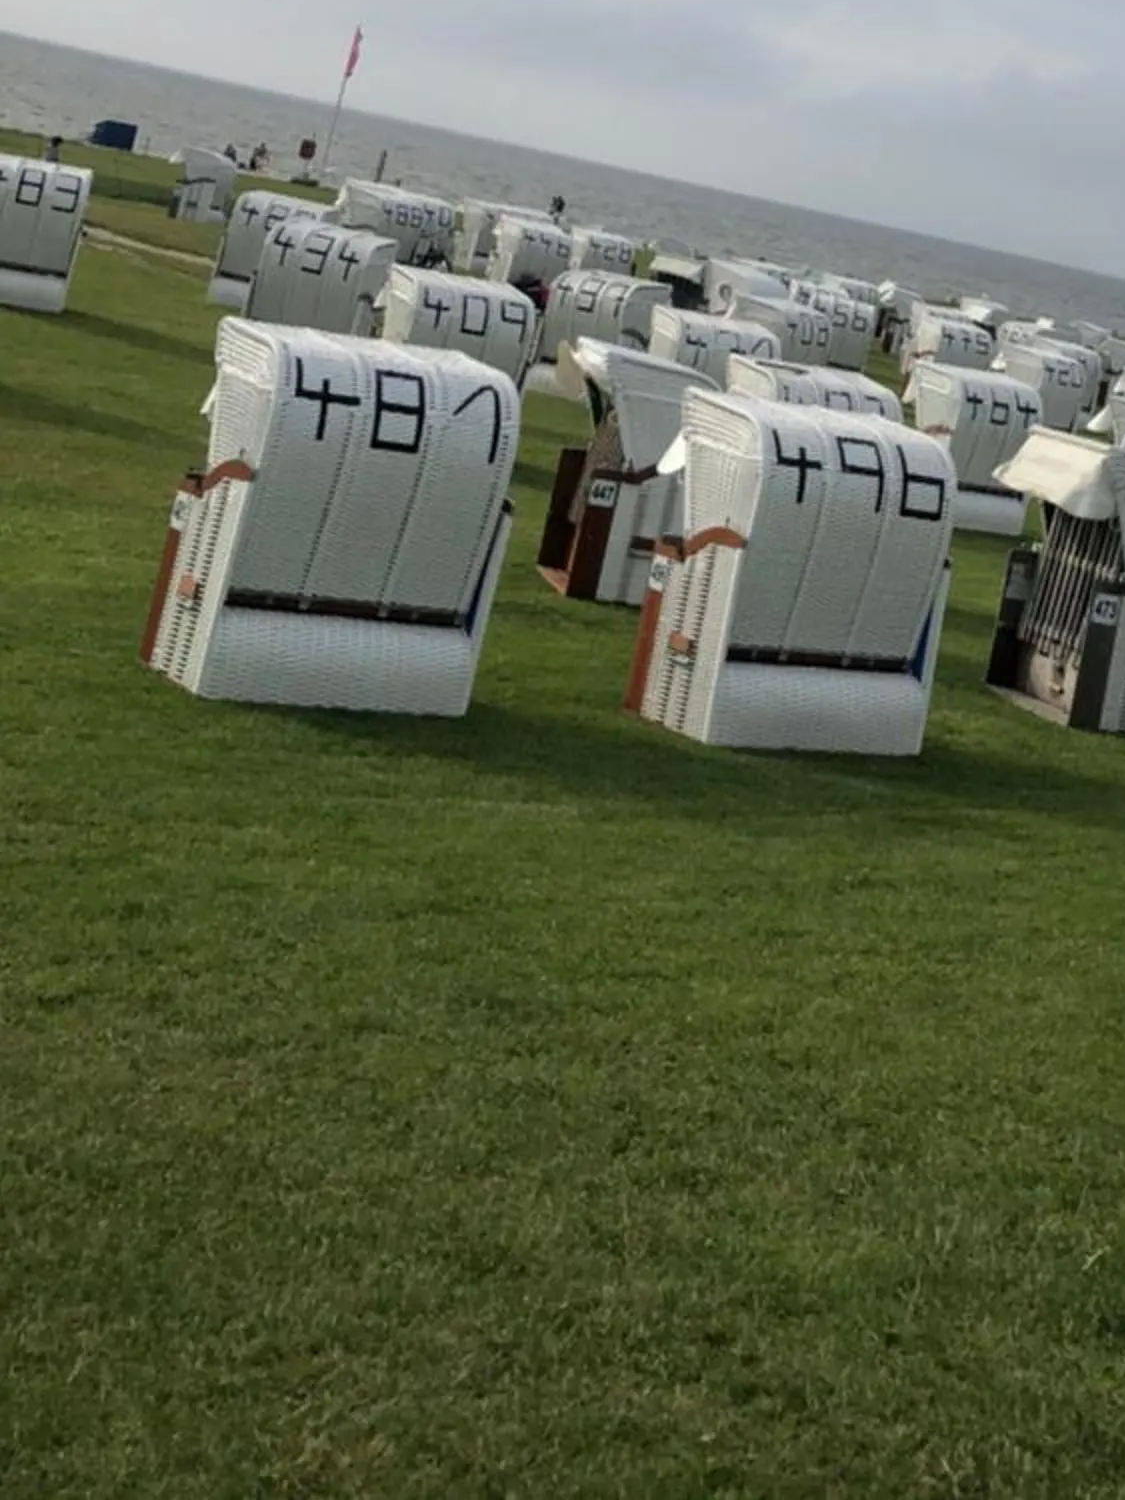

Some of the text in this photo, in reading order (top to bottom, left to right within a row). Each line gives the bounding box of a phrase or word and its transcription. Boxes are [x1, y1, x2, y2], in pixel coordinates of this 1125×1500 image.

[273, 227, 360, 282] 434
[424, 286, 527, 344] 409
[295, 357, 500, 465] 481
[964, 382, 1039, 429] 464
[773, 428, 945, 521] 496
